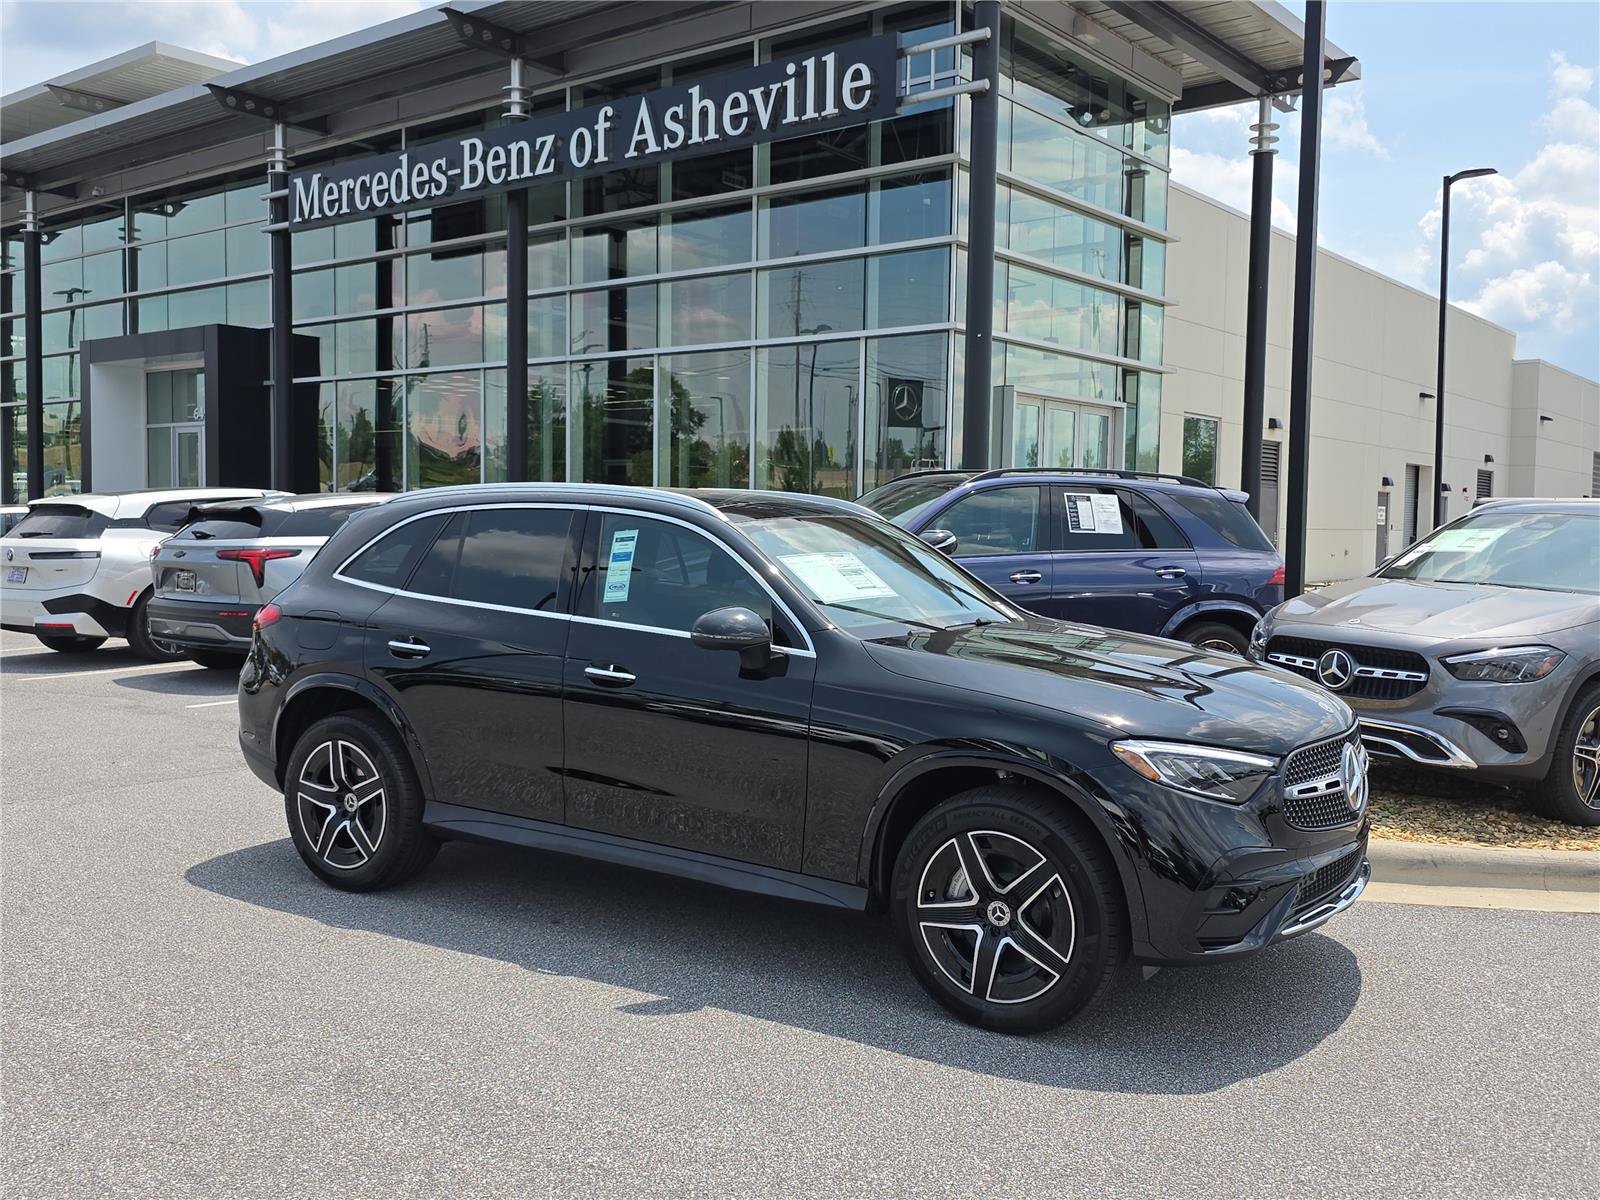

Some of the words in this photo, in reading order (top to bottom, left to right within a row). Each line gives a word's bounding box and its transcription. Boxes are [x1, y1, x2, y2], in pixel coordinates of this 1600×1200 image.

[293, 134, 556, 224] Mercedes-Benz
[569, 106, 613, 168] of
[624, 51, 872, 159] Asheville
